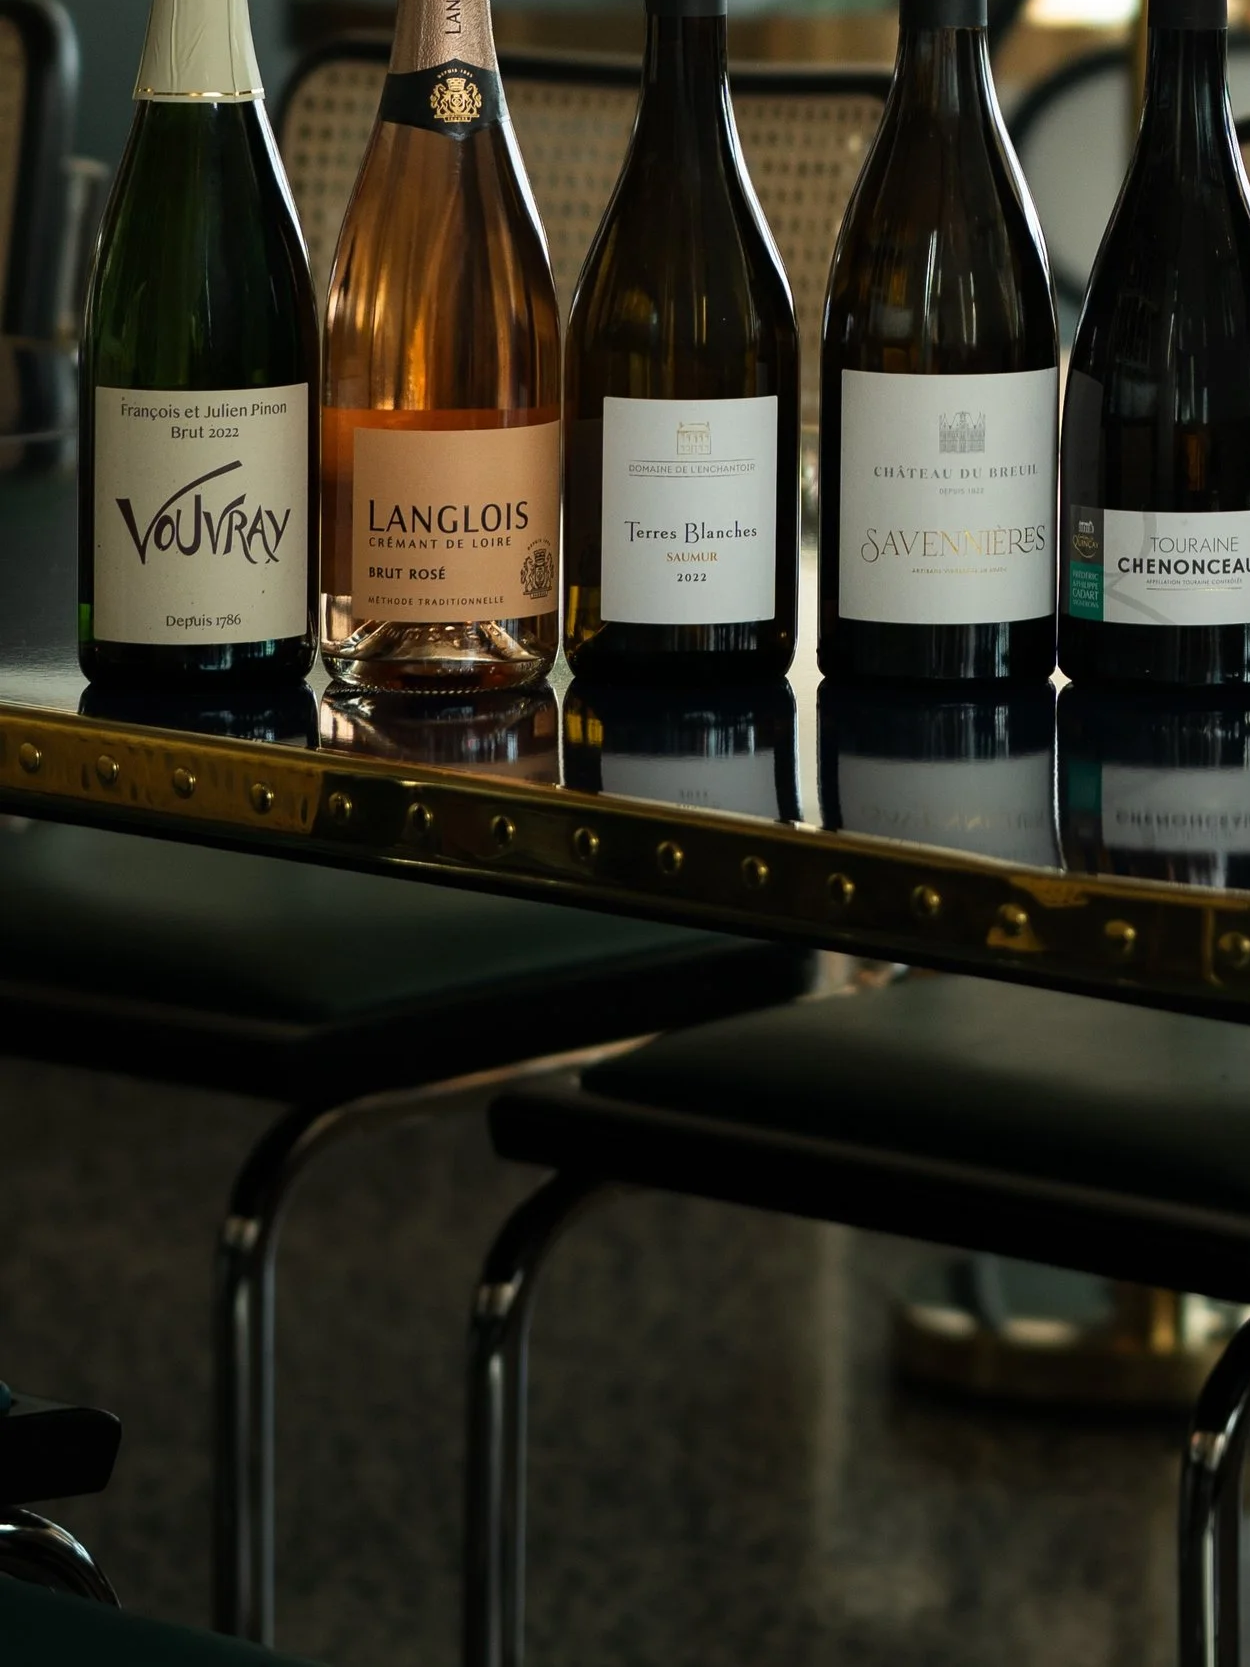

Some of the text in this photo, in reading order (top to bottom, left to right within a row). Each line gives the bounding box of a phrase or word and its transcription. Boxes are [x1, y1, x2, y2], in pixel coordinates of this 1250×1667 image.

[121, 401, 287, 421] François et Julien Pinon
[171, 425, 240, 440] Brut 2022
[628, 463, 756, 474] DOMAINE DE L'ENCHANTOIR
[873, 463, 1038, 480] CHÂTEAU DU BREUIL
[939, 487, 965, 496] DEPUIS
[369, 499, 529, 534] LANGLOIS
[624, 520, 758, 544] Terres Blanches
[368, 536, 439, 550] CRÉMANT
[446, 538, 464, 549] DE
[472, 536, 513, 549] LOIRE
[860, 524, 1046, 563] SAVENNIÈRES
[1149, 536, 1240, 554] TOURAINE
[666, 551, 718, 563] SAUMUR
[368, 565, 447, 581] BRUT ROSÉ
[676, 572, 707, 583] 2022
[368, 595, 505, 606] MÉTHODE TRADITIONNELLE
[1072, 587, 1099, 601] CADART
[165, 614, 242, 630] Depuis 1786
